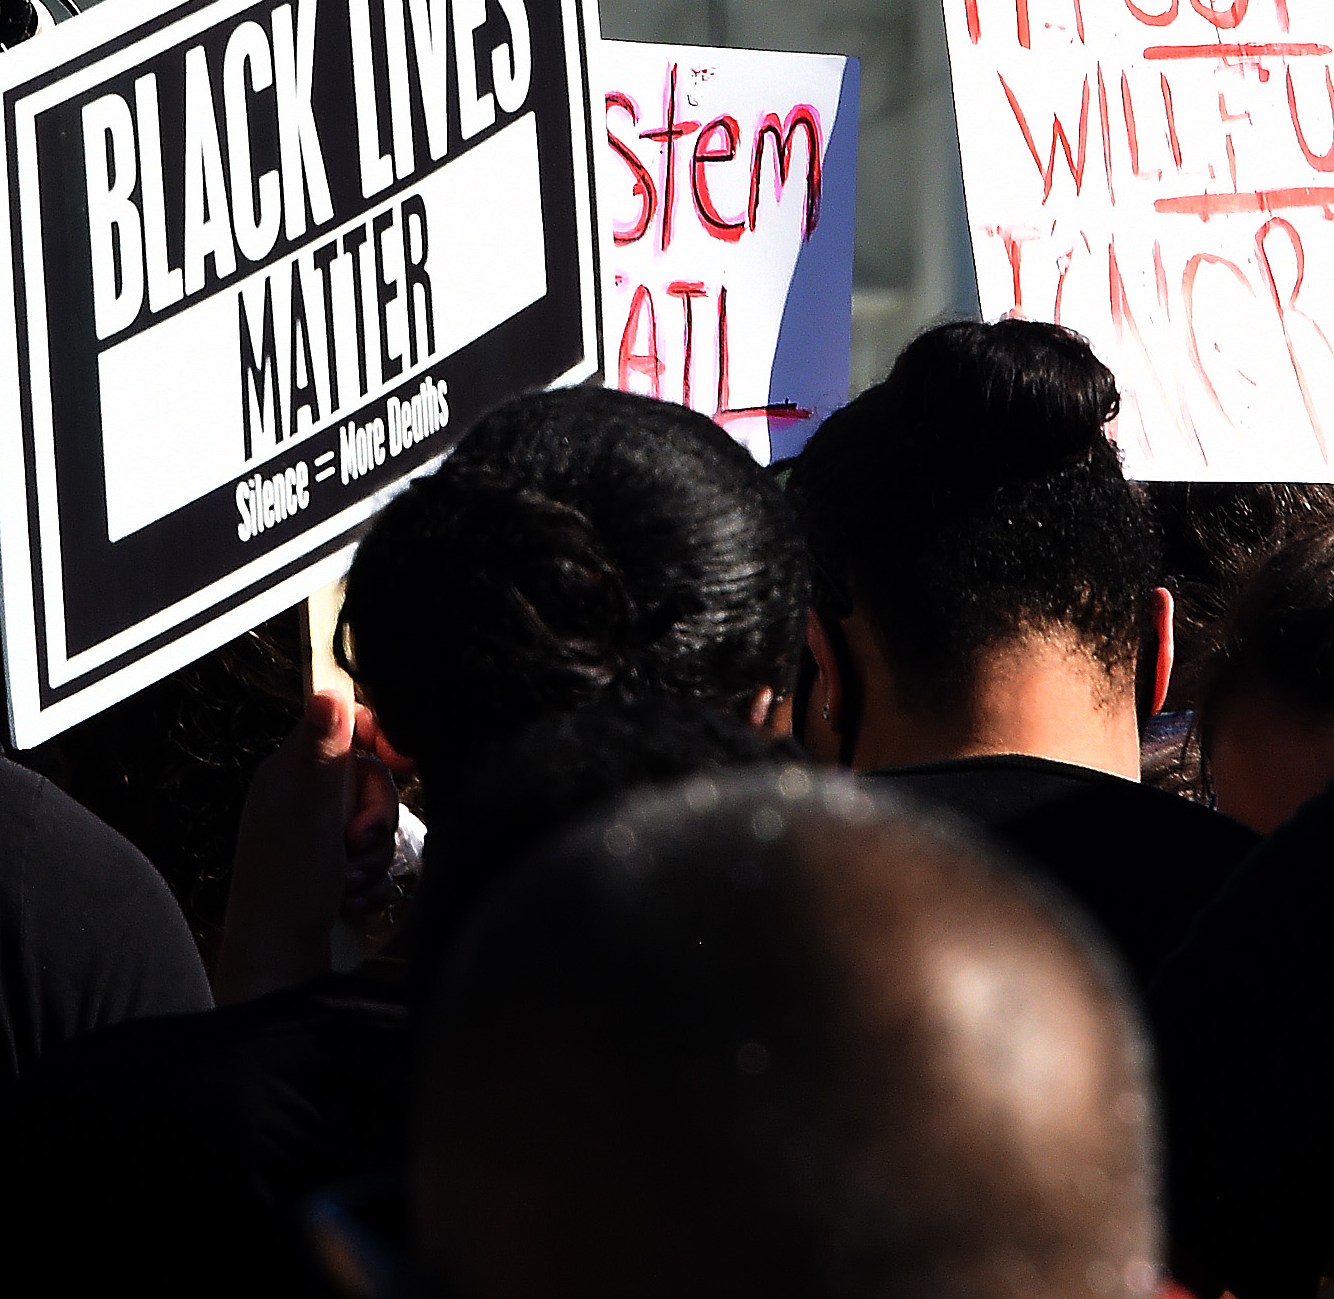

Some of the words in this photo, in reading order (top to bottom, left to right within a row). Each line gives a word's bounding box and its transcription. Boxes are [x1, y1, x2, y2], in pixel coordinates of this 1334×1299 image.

[238, 193, 436, 463] MATTER
[236, 461, 310, 542] Silence
[339, 417, 386, 485] More
[387, 376, 450, 457] Deaths
